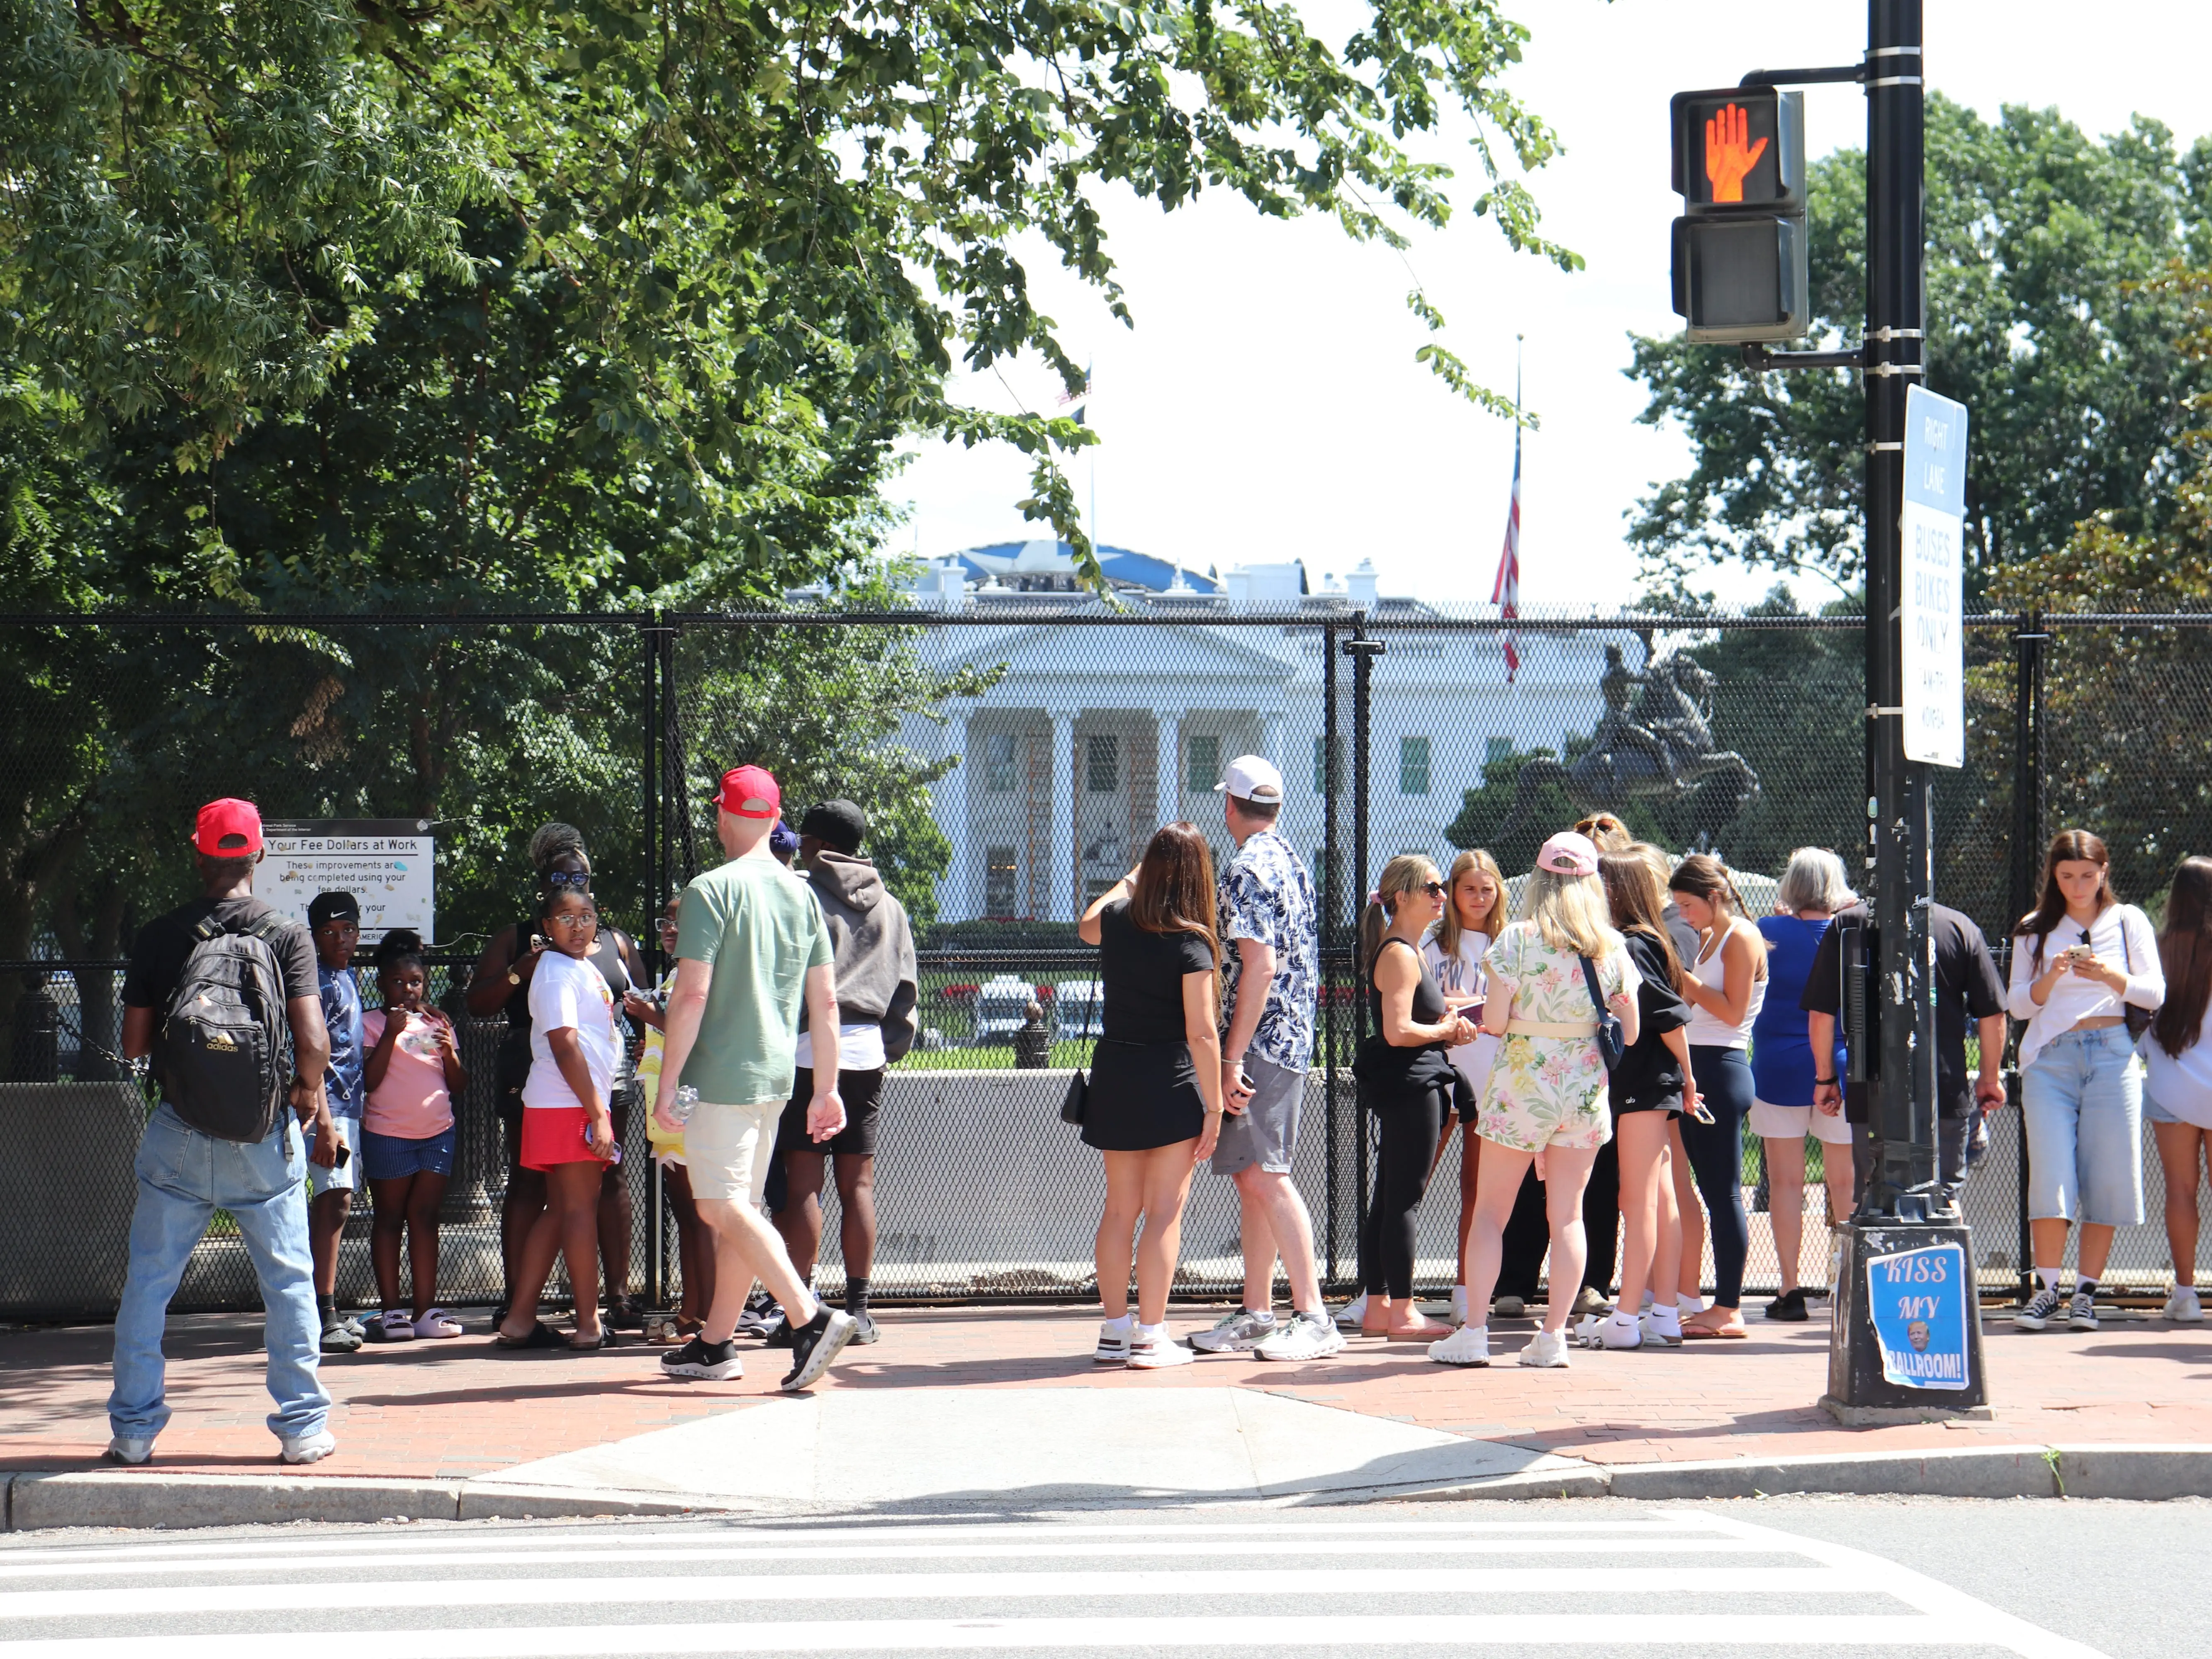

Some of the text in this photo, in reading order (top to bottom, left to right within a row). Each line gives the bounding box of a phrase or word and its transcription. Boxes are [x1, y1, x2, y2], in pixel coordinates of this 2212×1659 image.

[1924, 416, 1949, 450] RIGHT
[1924, 461, 1945, 495] LANE
[1916, 523, 1950, 568] BUSES
[1916, 571, 1950, 614] BIKES
[1917, 614, 1949, 654] ONLY
[268, 839, 417, 850] Your Fee Dollars at Work
[316, 861, 381, 871] improvements
[358, 873, 382, 883] using
[385, 874, 405, 883] your
[365, 905, 386, 914] your
[207, 1043, 238, 1052] adidas
[1883, 1256, 1947, 1283] KISS
[1898, 1296, 1940, 1319] MY
